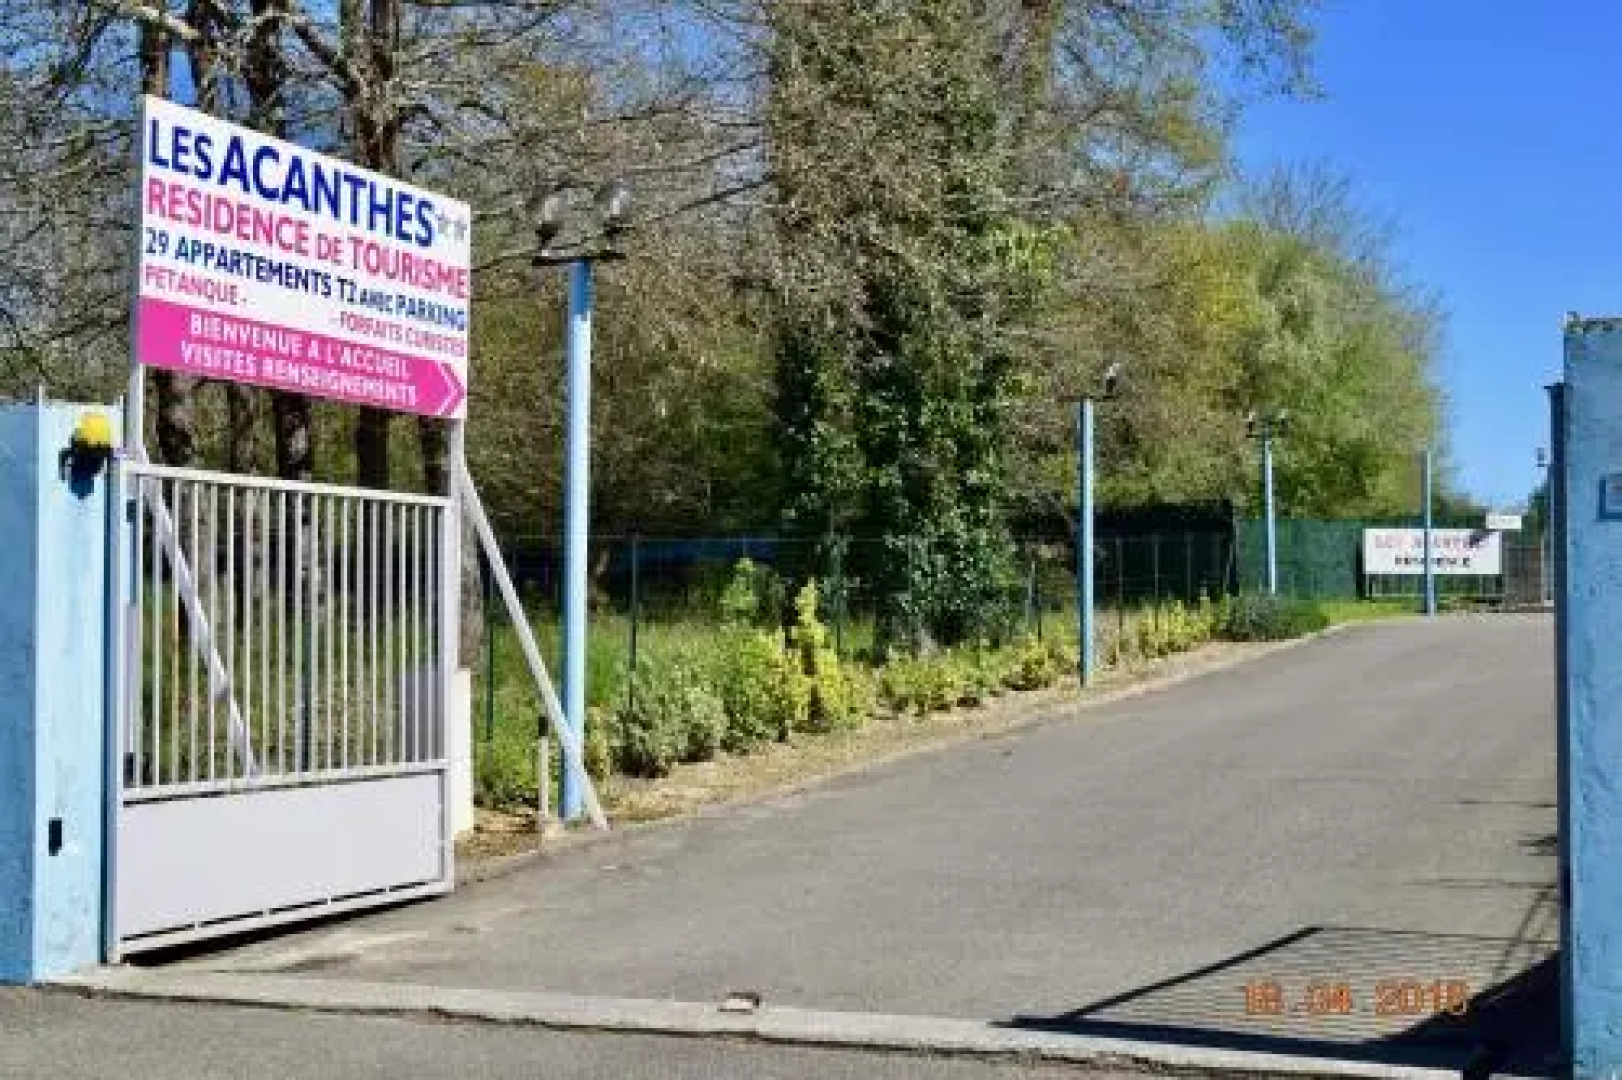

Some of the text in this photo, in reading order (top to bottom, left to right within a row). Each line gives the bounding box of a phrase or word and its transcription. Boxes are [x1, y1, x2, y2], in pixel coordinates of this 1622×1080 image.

[147, 177, 468, 300] RESIDENCE DE TOURISME
[148, 118, 434, 247] LES ACANTHES
[145, 227, 169, 255] 29
[175, 236, 332, 297] APPARTEMENTS
[395, 294, 466, 332] PARKING
[190, 312, 303, 358] BIENVENUE
